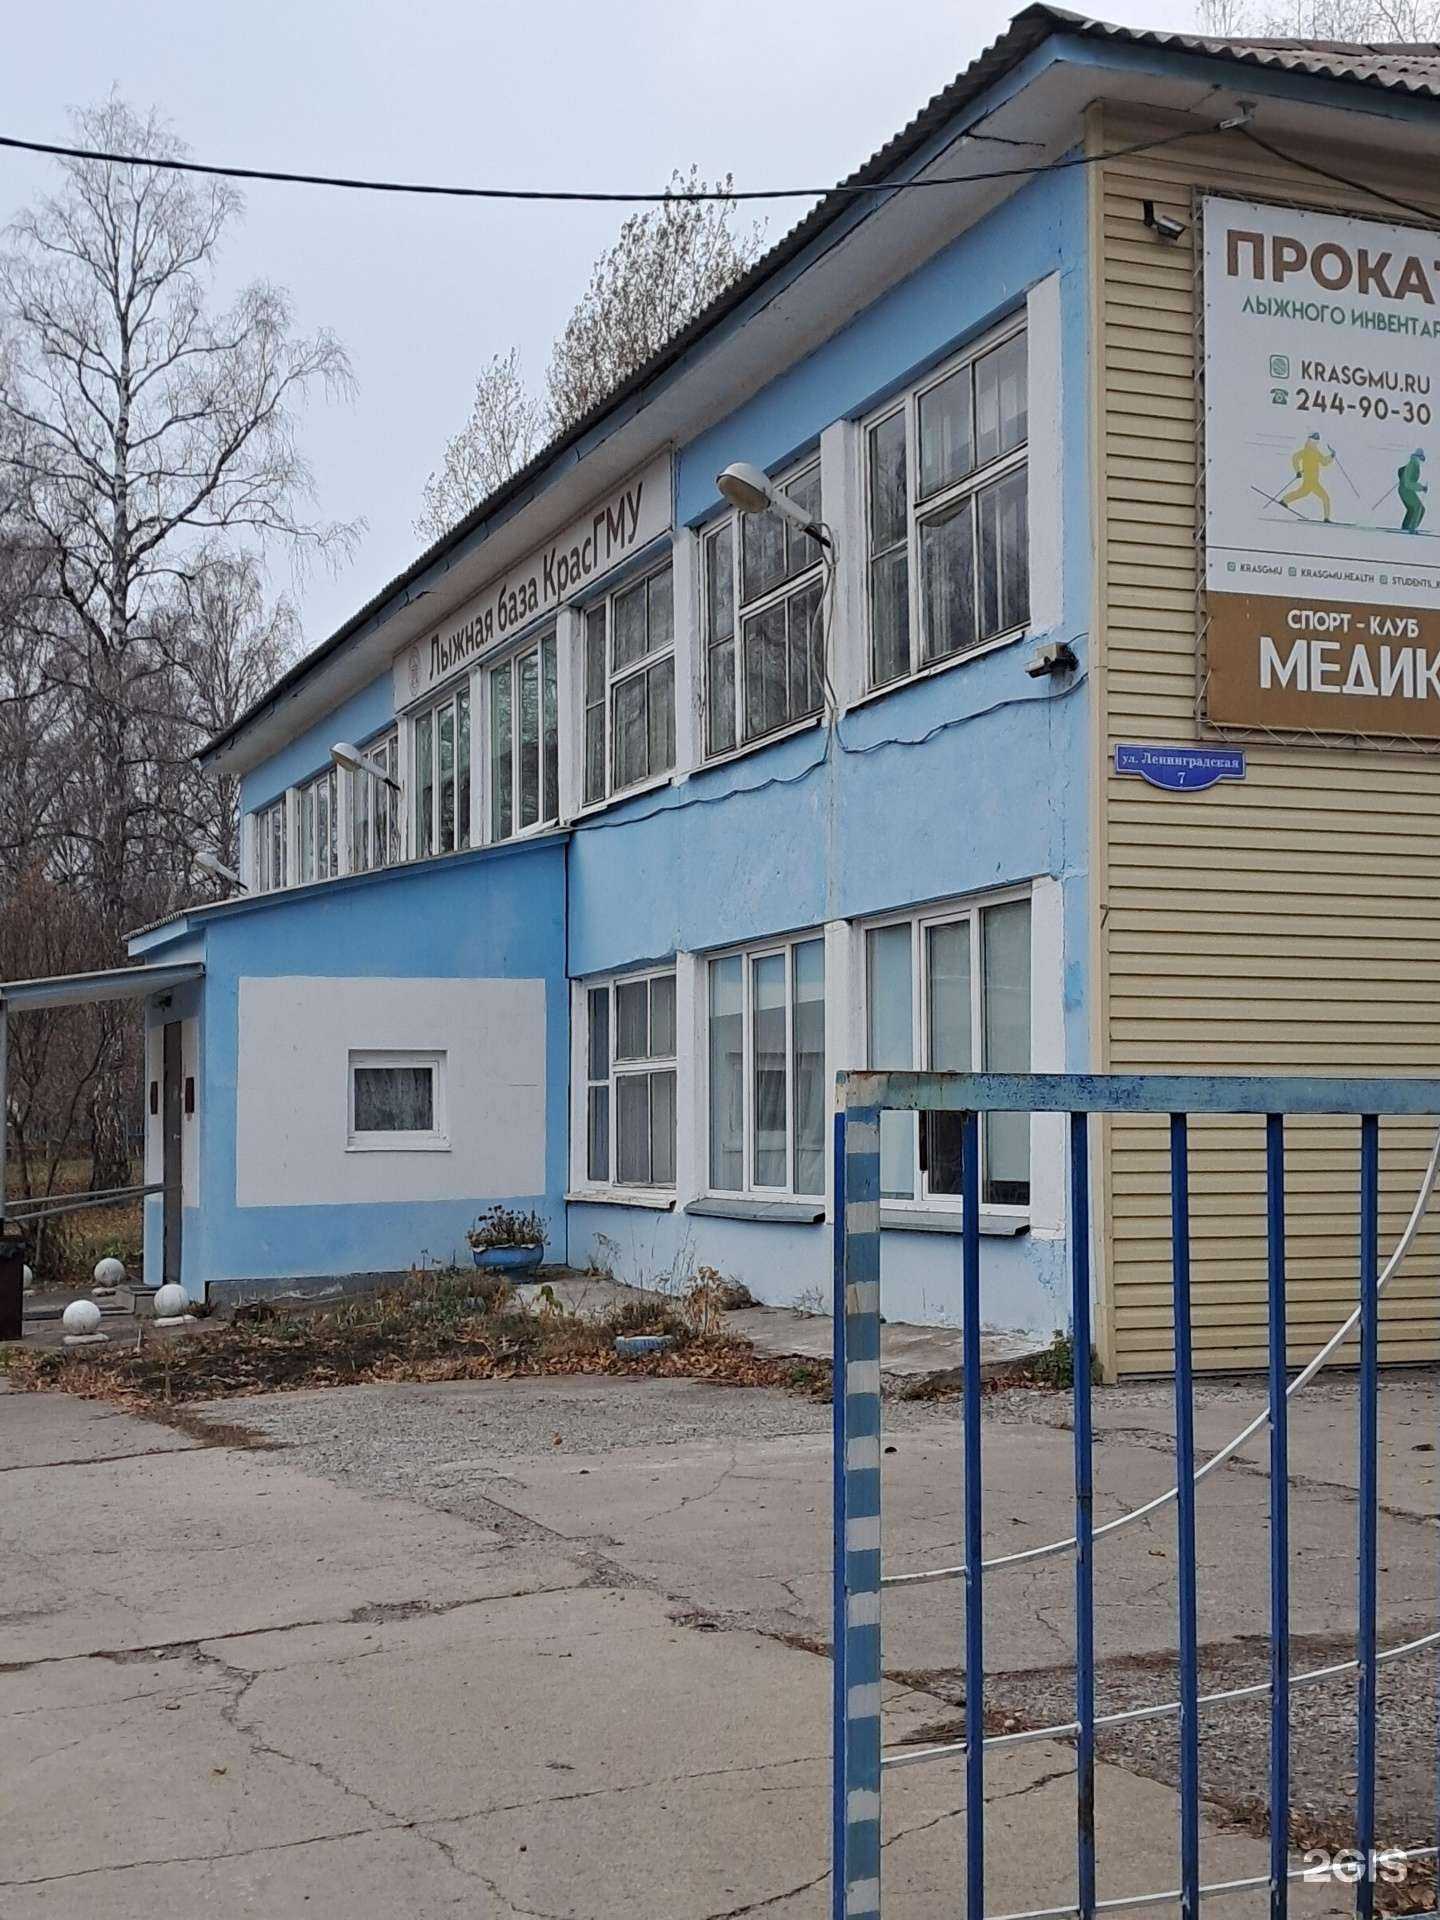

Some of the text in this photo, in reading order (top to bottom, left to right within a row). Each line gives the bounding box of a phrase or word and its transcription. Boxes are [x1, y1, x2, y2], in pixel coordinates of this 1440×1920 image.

[1226, 229, 1440, 305] ПРОКА
[1241, 296, 1346, 326] ЛЫЖНОГО
[1301, 360, 1431, 395] KRASGMU.RU
[1296, 388, 1431, 425] 244-90-30
[429, 481, 643, 681] Лыжная база КрасГМУ
[1240, 563, 1283, 576] KRASGMU
[1287, 609, 1352, 633] СПОРТ
[1370, 616, 1419, 638] КЛУБ
[1260, 636, 1440, 699] МЕДИК
[1122, 752, 1240, 769] ул. Ленинградская
[1177, 772, 1186, 784] 7
